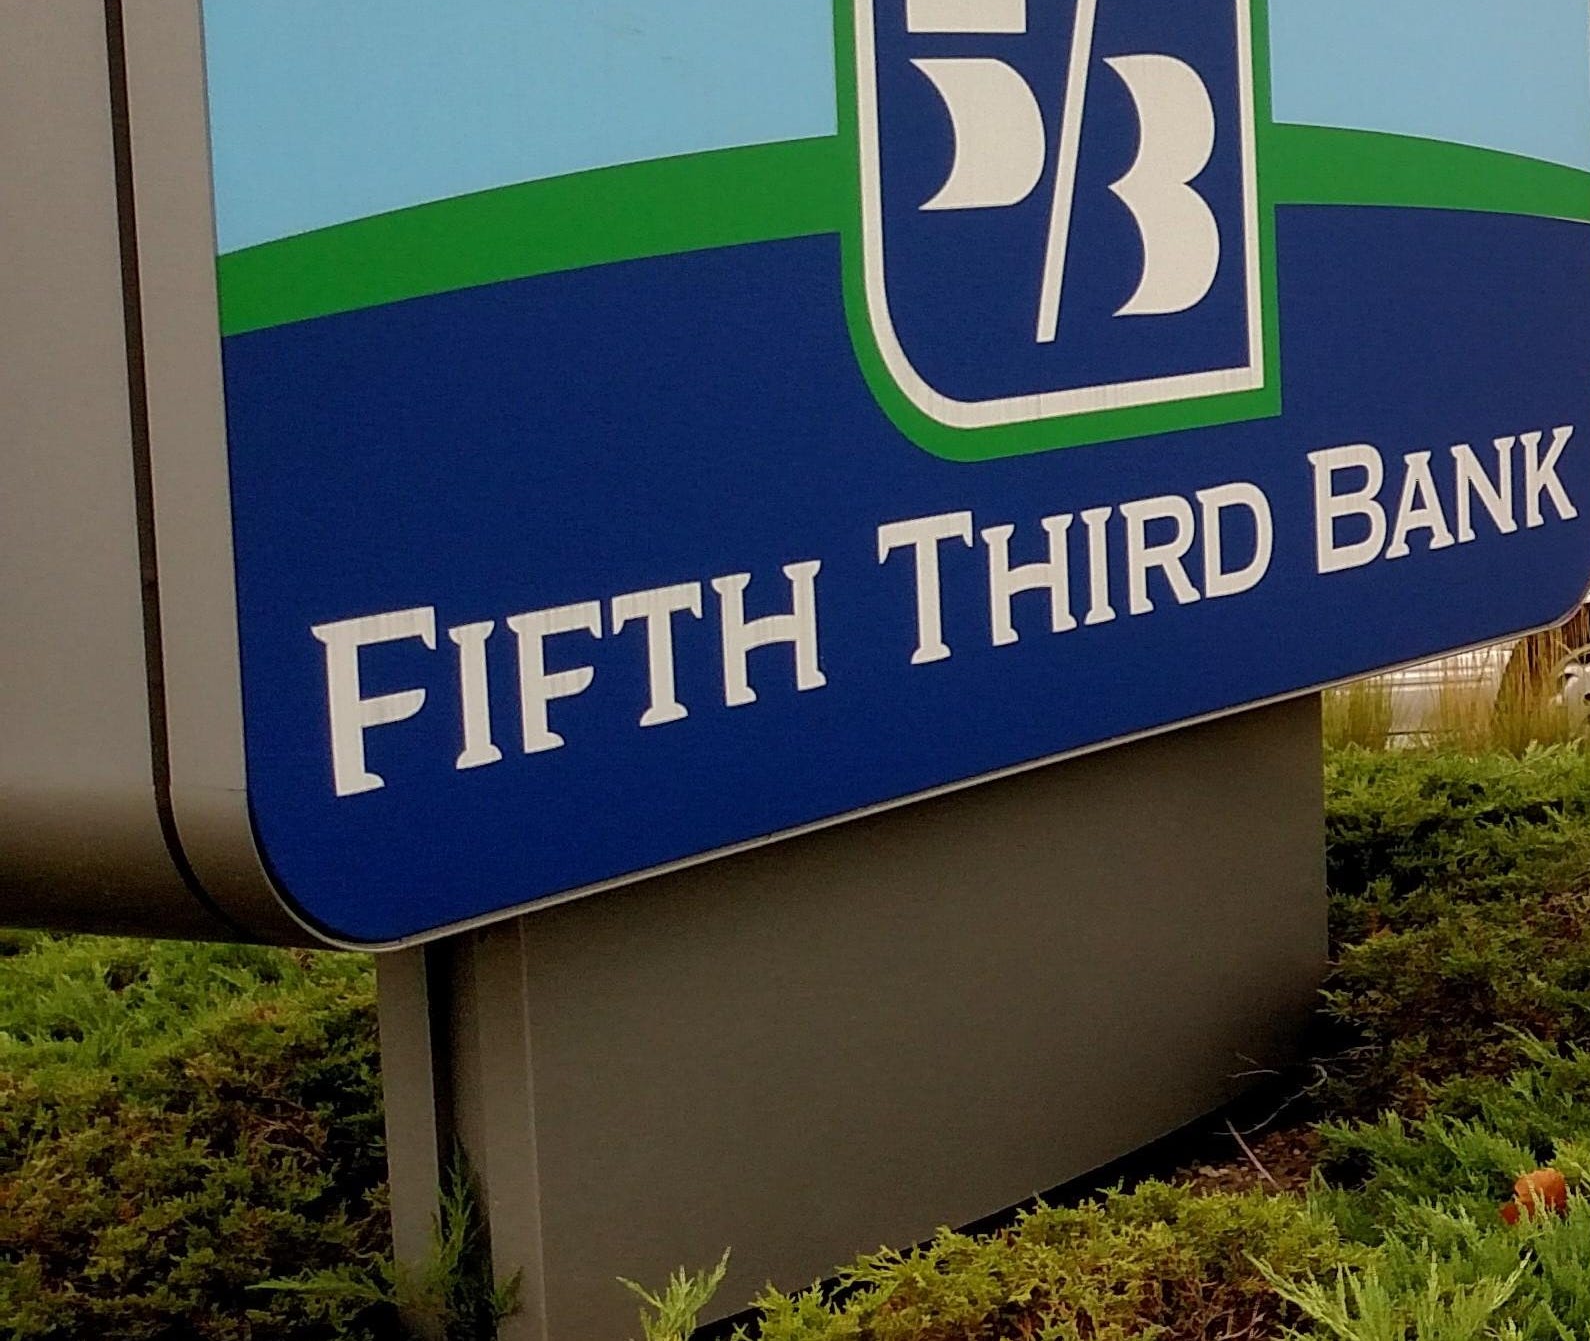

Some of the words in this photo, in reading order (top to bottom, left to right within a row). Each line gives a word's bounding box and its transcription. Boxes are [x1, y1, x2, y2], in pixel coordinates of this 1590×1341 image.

[310, 559, 828, 797] FIFTH
[876, 481, 1274, 665] THIRD
[1306, 425, 1579, 575] BANK
